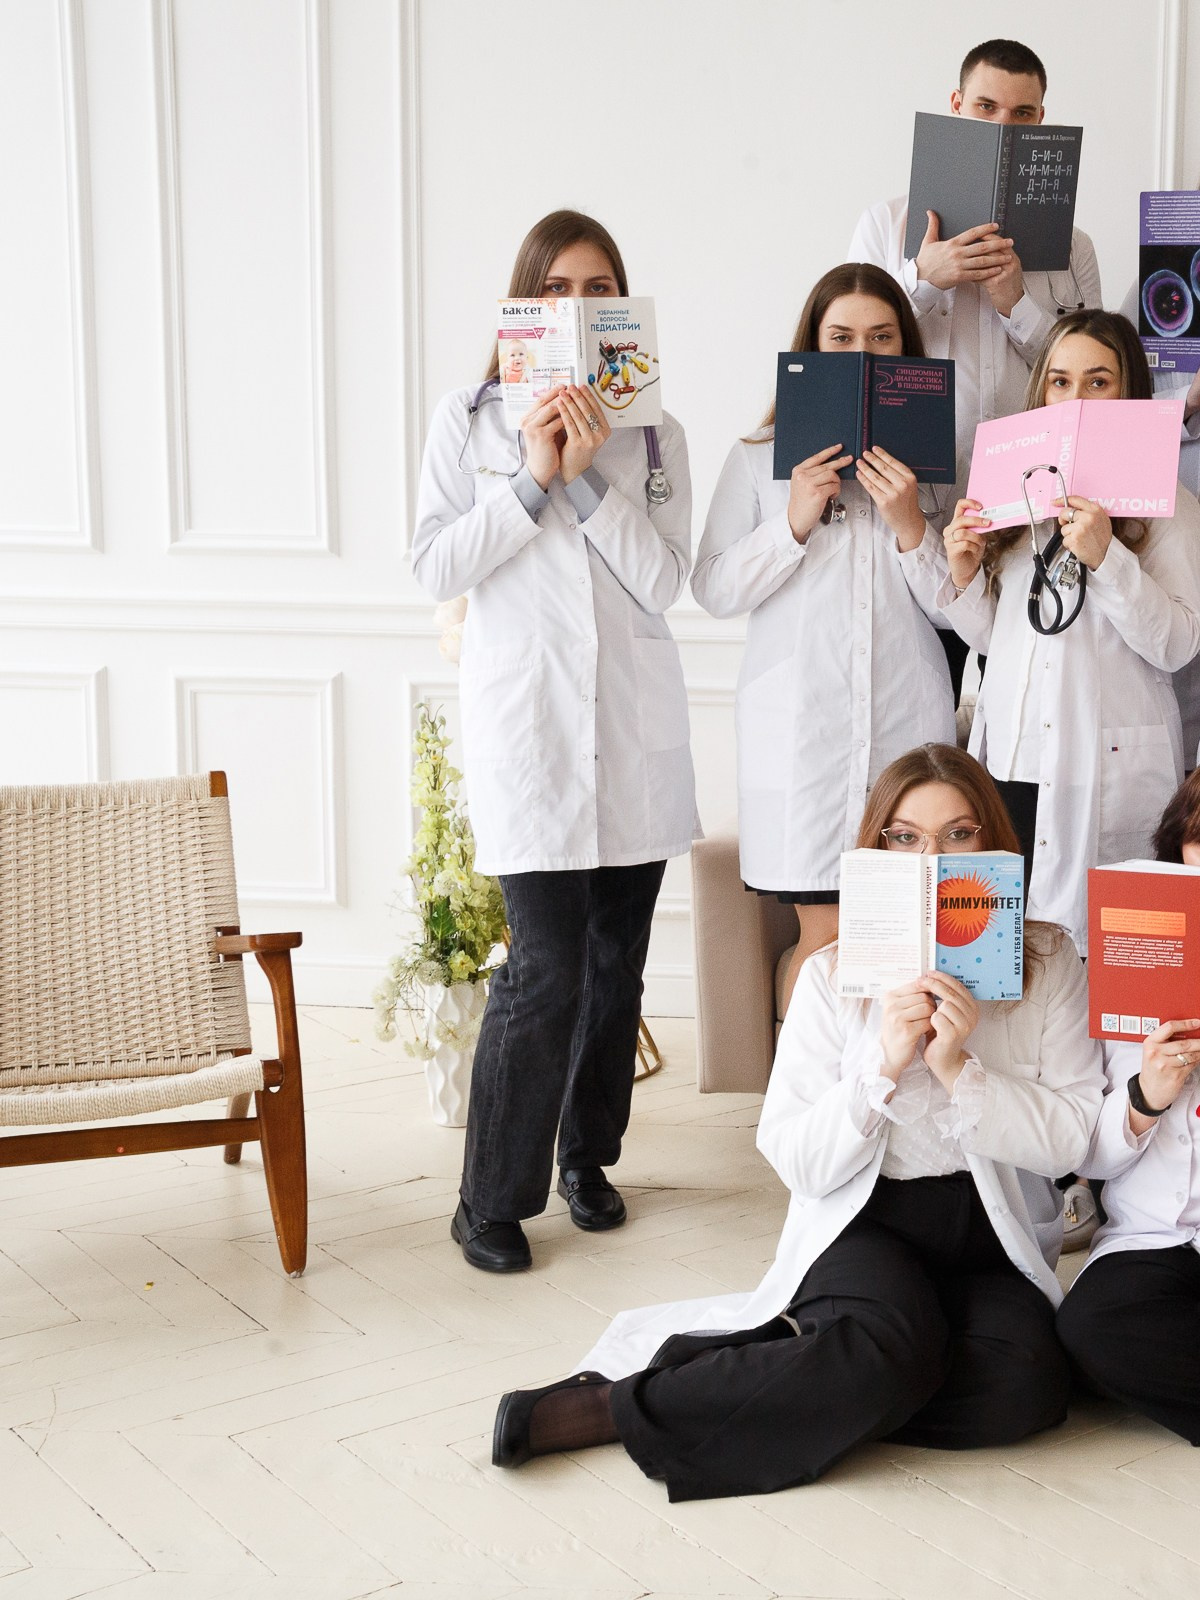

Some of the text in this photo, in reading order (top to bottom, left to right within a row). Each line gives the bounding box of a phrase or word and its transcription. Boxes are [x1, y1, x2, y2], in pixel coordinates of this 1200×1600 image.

[590, 323, 640, 332] ПЕДИАТРИИ
[896, 368, 943, 377] СИНДРОМНАЯ
[894, 375, 943, 384] ДИАГНОСТИКА
[904, 383, 943, 391] ПЕДИАТРИИ
[985, 432, 1048, 457] NEW.TONE
[940, 897, 1021, 910] ИММУНИТЕТ
